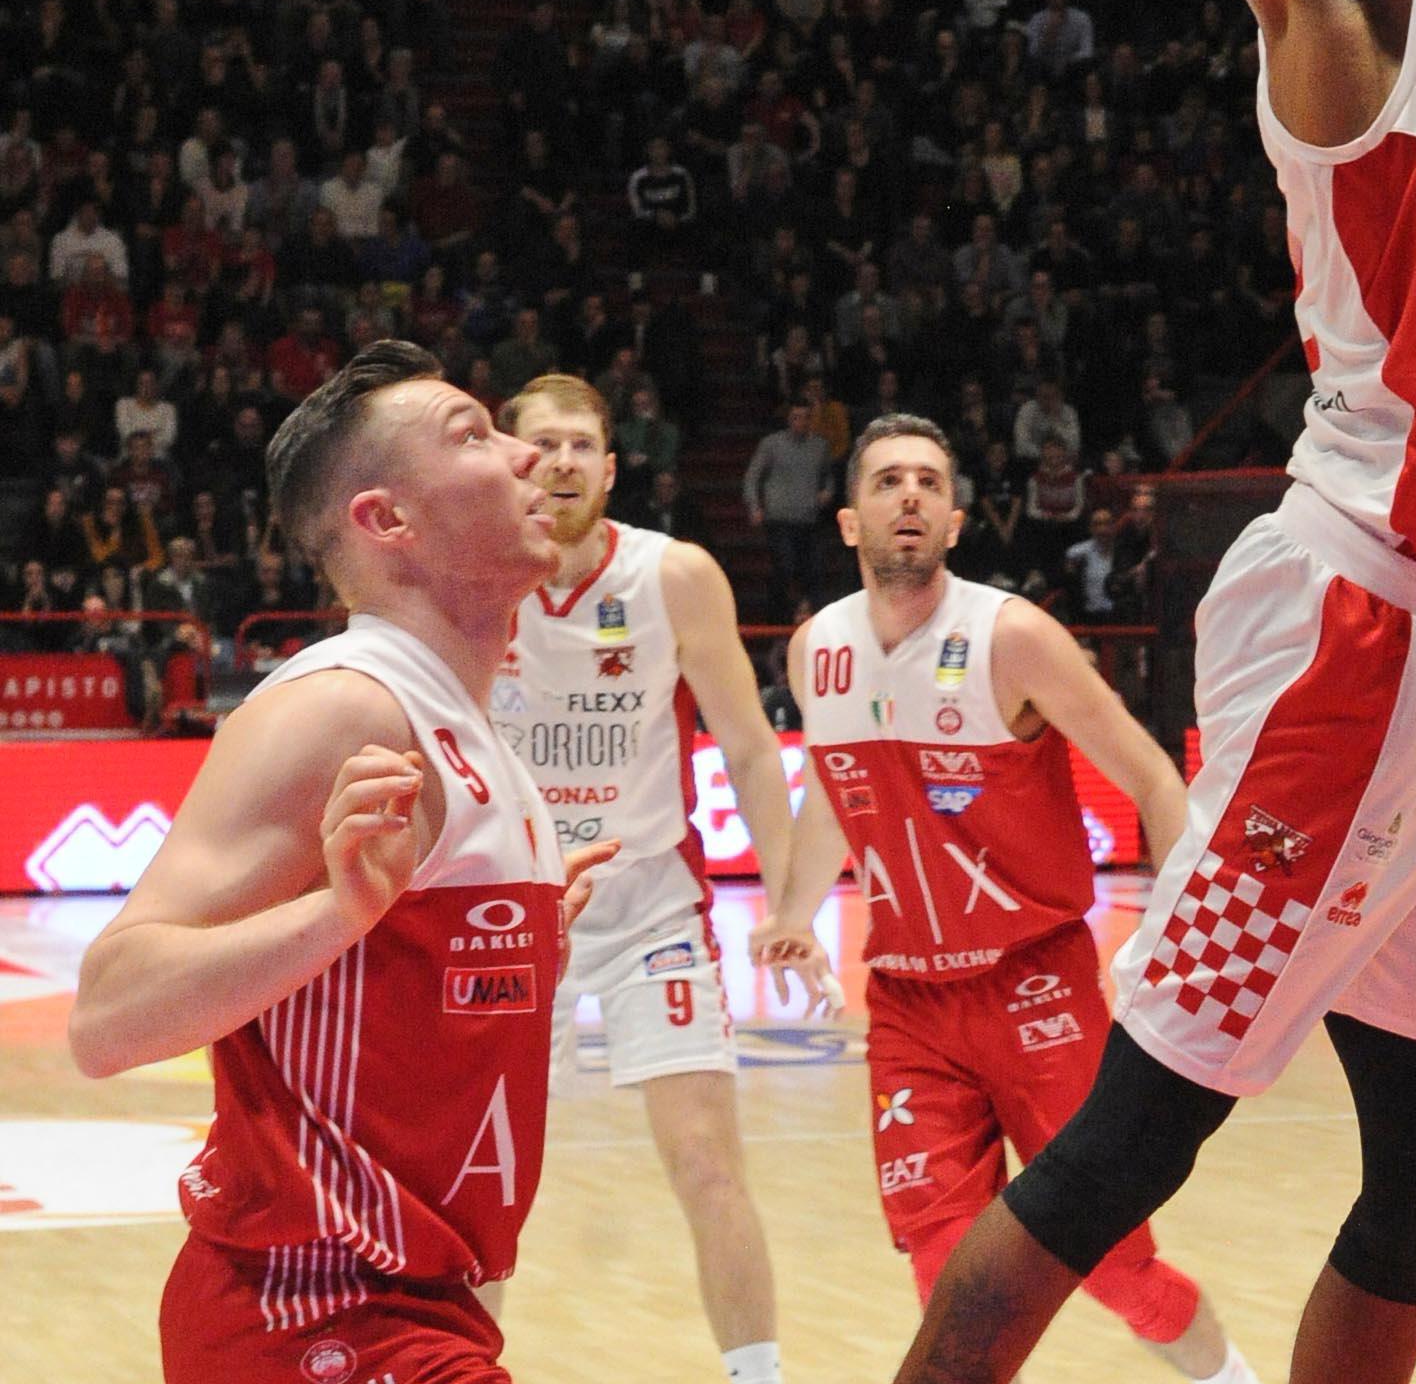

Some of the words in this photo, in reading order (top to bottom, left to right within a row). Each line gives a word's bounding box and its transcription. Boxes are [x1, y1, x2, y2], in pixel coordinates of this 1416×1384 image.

[568, 690, 645, 712] FLEXX
[531, 721, 641, 770] ORIOR
[927, 790, 974, 813] SAP
[554, 817, 602, 844] BO
[665, 980, 694, 1027] 9
[881, 1152, 928, 1189] EA7
